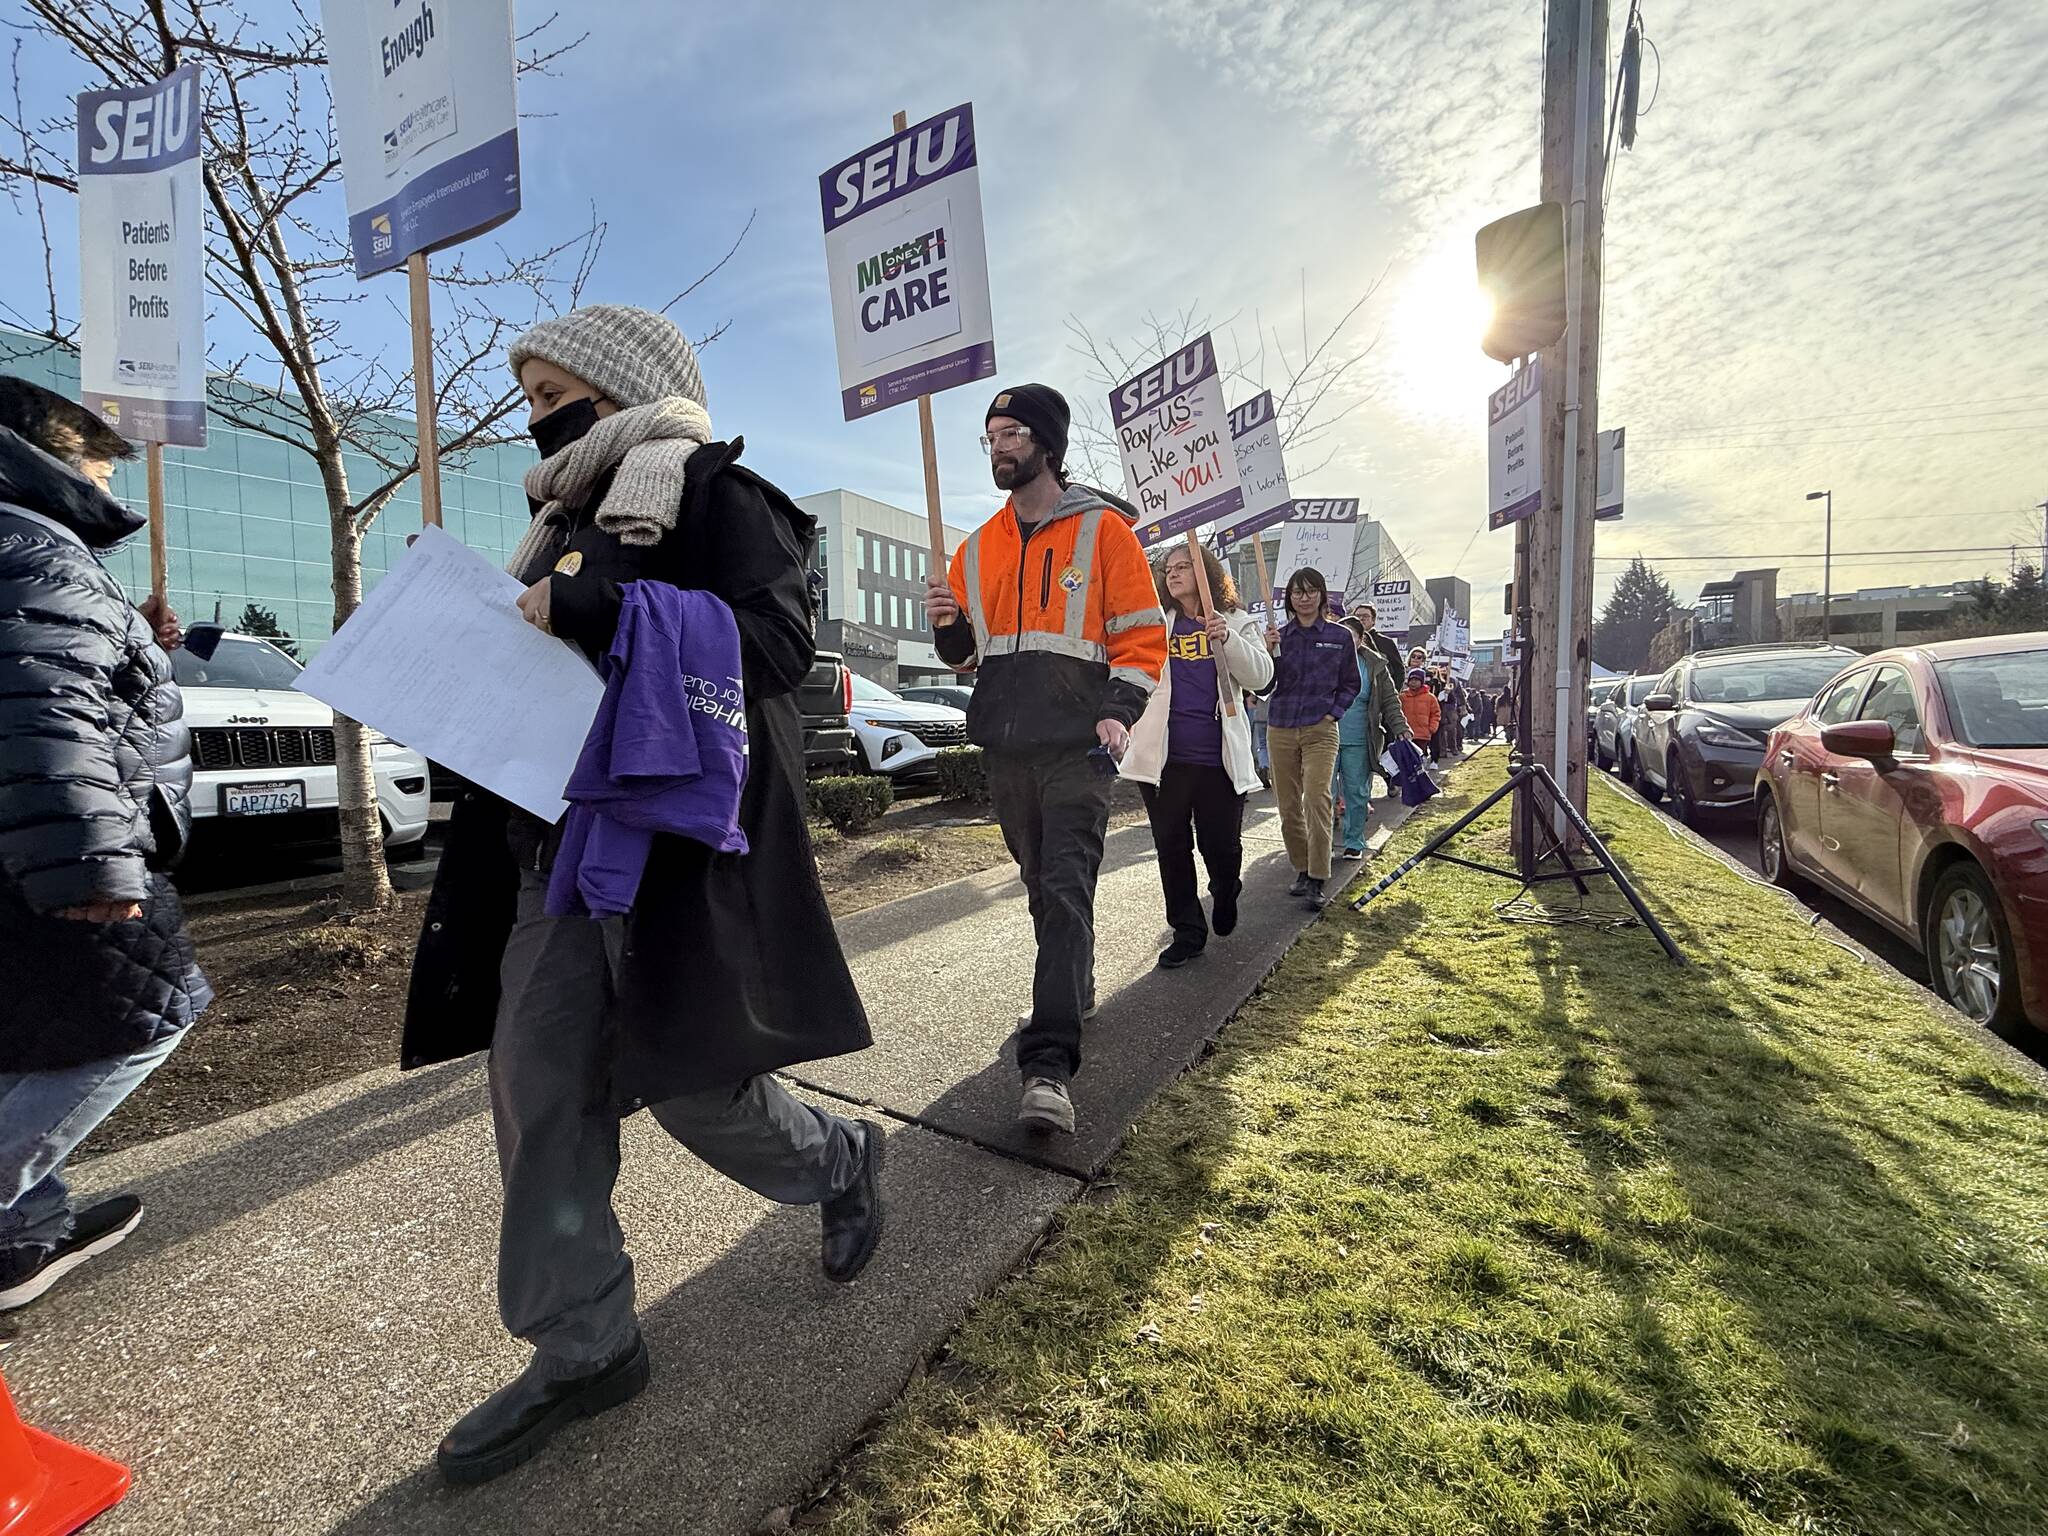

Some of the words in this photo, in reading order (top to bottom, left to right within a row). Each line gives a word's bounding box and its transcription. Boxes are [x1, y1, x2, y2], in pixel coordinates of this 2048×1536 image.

[381, 1, 434, 77] Enough
[91, 79, 191, 163] SEIU
[471, 168, 489, 184] Union
[834, 115, 960, 219] SEIU
[122, 220, 170, 244] Patients
[373, 235, 392, 254] SEIU
[129, 258, 168, 281] Before
[129, 295, 169, 318] Profits
[862, 267, 950, 333] CARE
[903, 371, 926, 383] Employees
[926, 363, 954, 375] International
[955, 358, 970, 367] Union
[1121, 342, 1204, 419] SEIU
[861, 395, 877, 407] SEIU
[1492, 365, 1536, 420] SEIU
[1121, 424, 1152, 455] Pay
[1184, 430, 1219, 463] you
[1141, 488, 1167, 513] Pay
[1172, 451, 1223, 496] YOU!
[1290, 501, 1354, 520] SEIU
[1296, 526, 1329, 541] United
[1295, 553, 1322, 566] Fair
[1376, 582, 1408, 595] SEIU
[1251, 600, 1284, 613] SEU
[1170, 634, 1209, 657] SEI
[720, 688, 741, 706] for
[227, 715, 269, 725] Jeep
[685, 694, 748, 733] UHeal
[229, 793, 300, 812] CAP7762
